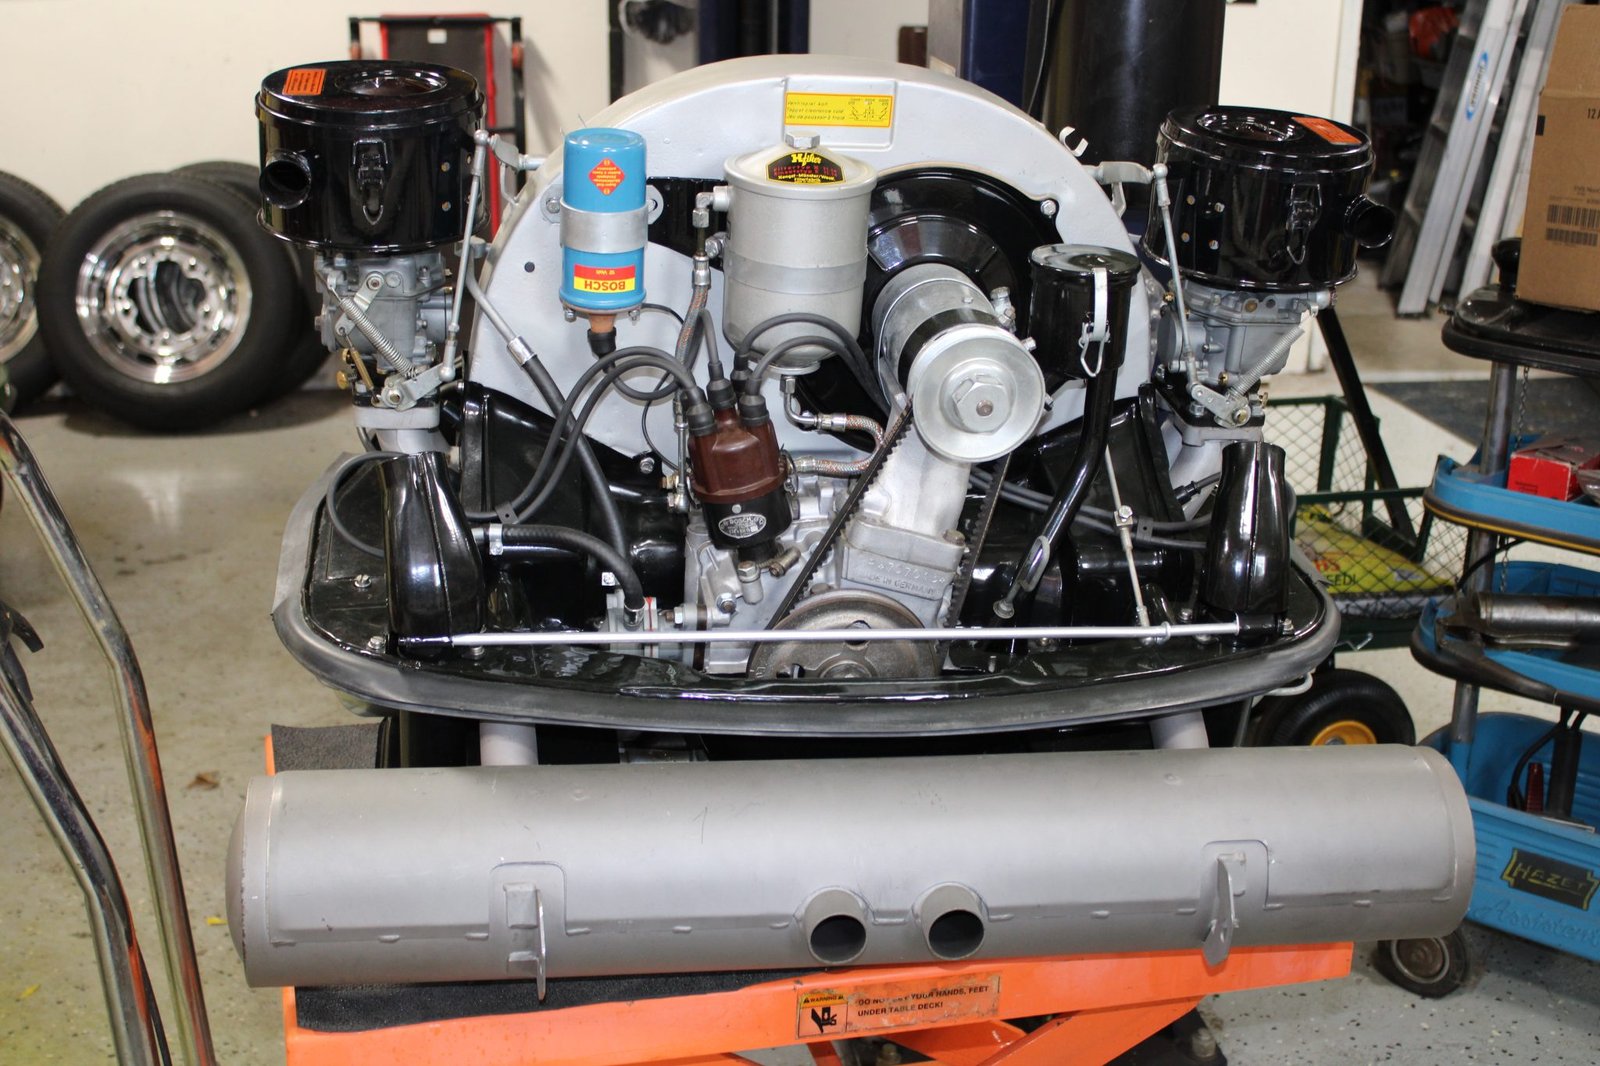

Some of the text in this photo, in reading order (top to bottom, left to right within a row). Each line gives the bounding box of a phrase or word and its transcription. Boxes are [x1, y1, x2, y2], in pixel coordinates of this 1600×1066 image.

[584, 280, 626, 291] BOSCH
[1512, 862, 1587, 892] HAZET
[911, 991, 934, 1000] YOUR
[935, 987, 967, 998] HANDS,
[968, 985, 989, 994] FEET
[857, 1001, 944, 1017] UNDER TABLE DECK!
